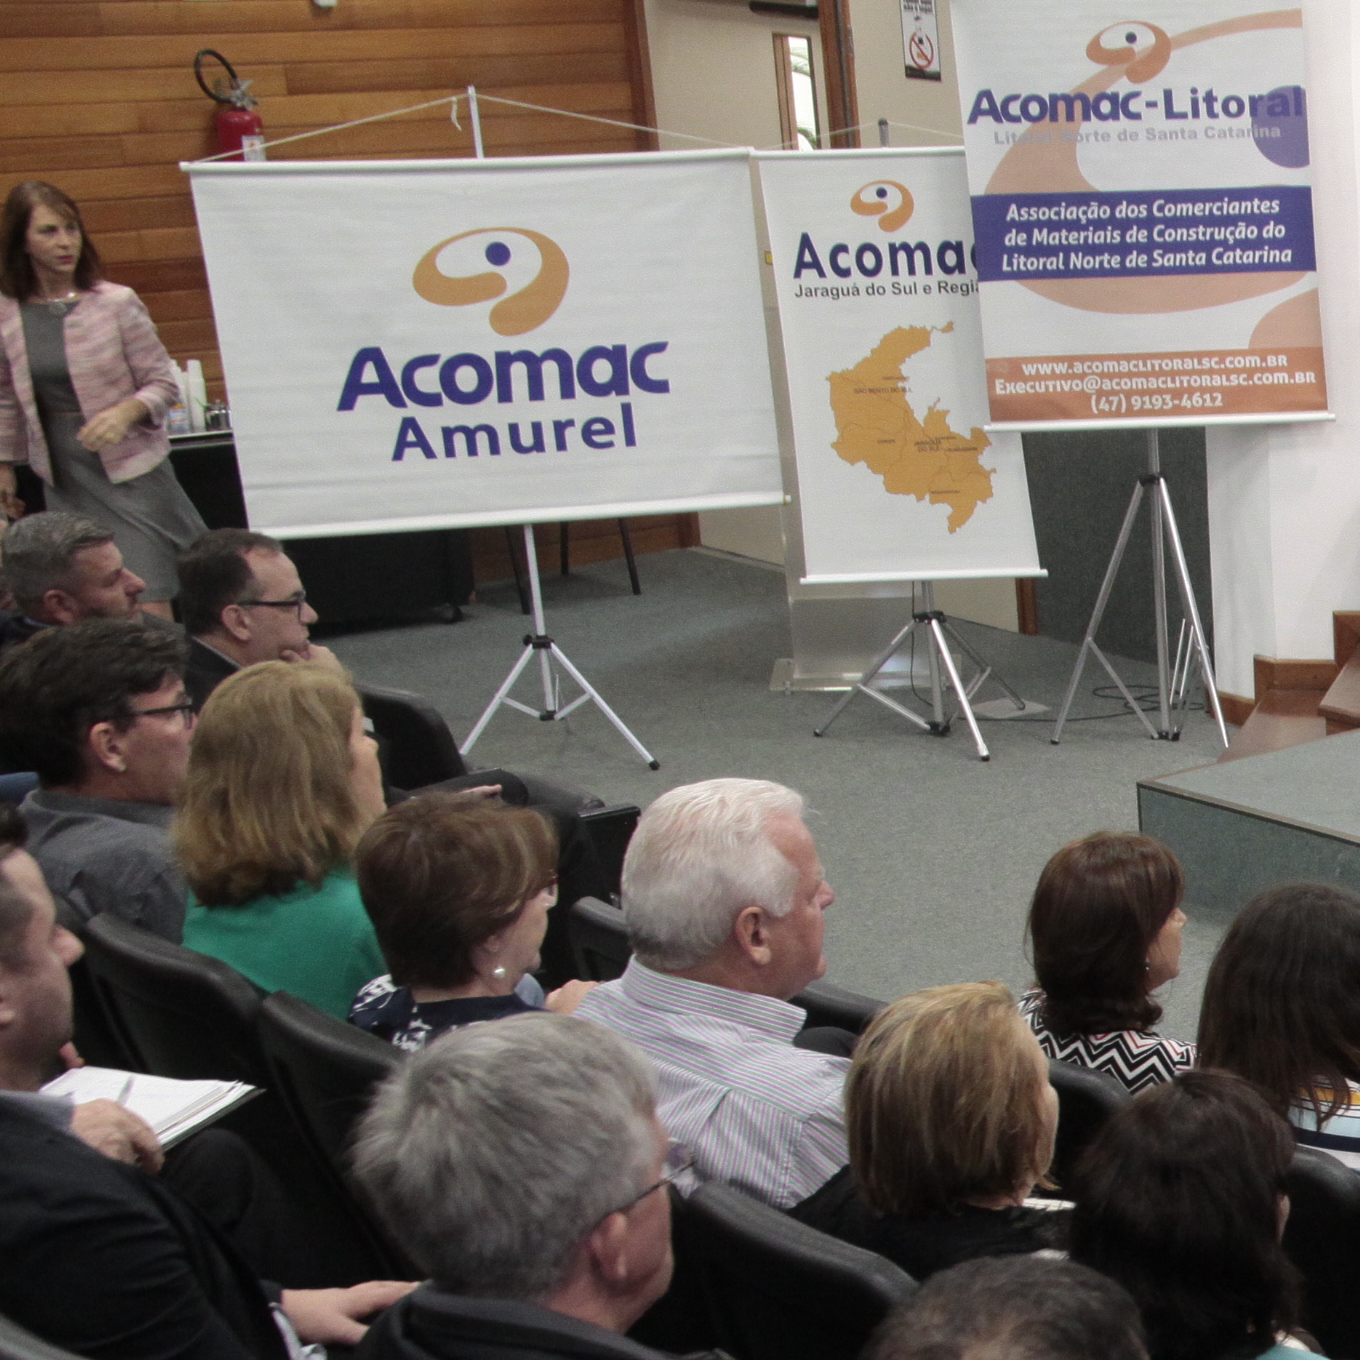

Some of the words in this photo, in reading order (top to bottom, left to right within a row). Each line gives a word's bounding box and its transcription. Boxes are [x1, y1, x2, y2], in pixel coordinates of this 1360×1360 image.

[967, 86, 1303, 125] Acomac-Litoral
[994, 130, 1051, 145] Litoral
[1060, 128, 1111, 143] Norte
[1117, 128, 1139, 142] de
[1145, 127, 1198, 141] Santa
[1204, 124, 1281, 139] Catarina
[1006, 202, 1110, 224] Associação
[1115, 200, 1148, 218] dos
[1152, 197, 1280, 217] Comerciantes
[1004, 228, 1027, 246] de
[1032, 226, 1121, 245] Materiais
[1125, 225, 1148, 243] de
[1152, 222, 1258, 244] Construção
[1262, 220, 1286, 239] do
[793, 231, 977, 279] Acoma
[1002, 252, 1065, 271] Litoral
[1069, 252, 1121, 270] Norte
[1125, 250, 1148, 268] de
[1152, 249, 1206, 267] Santa
[1211, 246, 1292, 265] Catarina
[795, 283, 860, 301] Jaraguá
[865, 282, 886, 296] do
[891, 281, 917, 296] Sul
[923, 284, 932, 294] e
[937, 280, 979, 297] Regi
[336, 340, 671, 412] Acomac
[1091, 394, 1127, 414] (47)
[1131, 392, 1224, 410] 9193-4612
[391, 402, 638, 461] Amurel
